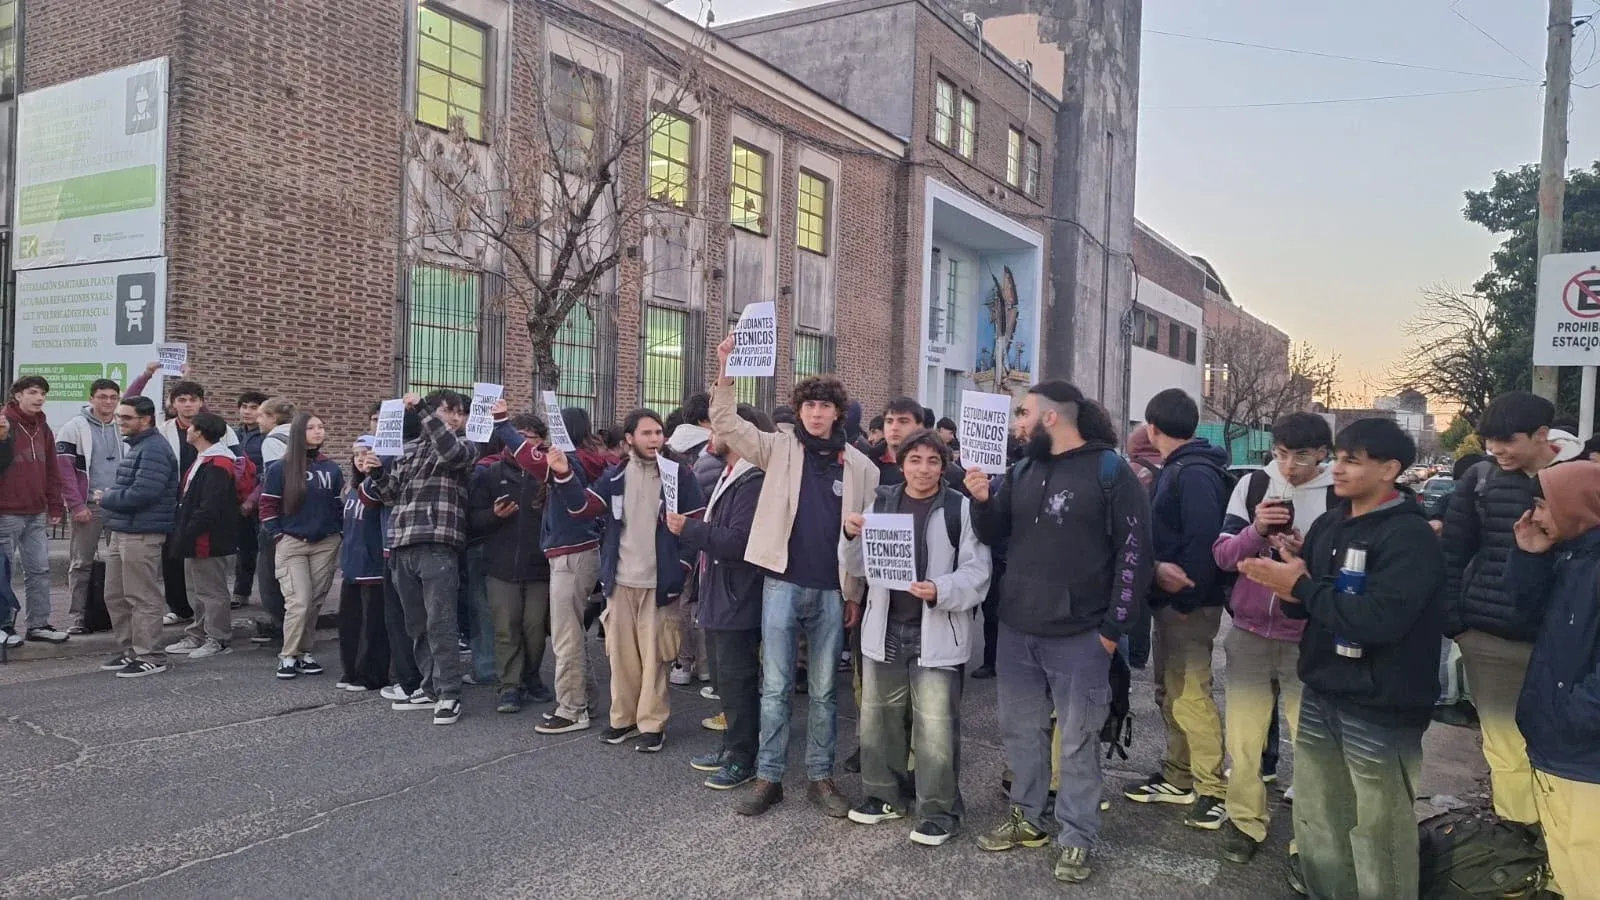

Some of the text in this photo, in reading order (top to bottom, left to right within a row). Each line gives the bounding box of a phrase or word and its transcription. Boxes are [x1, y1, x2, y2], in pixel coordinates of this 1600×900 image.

[1558, 321, 1600, 333] PROHIB
[1553, 336, 1600, 347] ESTACIO
[730, 356, 772, 367] SIN FUTURO
[964, 406, 1007, 425] ESTUDIANTES
[963, 420, 1005, 442] TECNICOS
[971, 450, 1002, 466] FUTURO
[865, 528, 912, 542] ESTUDIANTES
[866, 541, 912, 558] TECNICOS
[868, 567, 913, 582] SIN FUTURO
